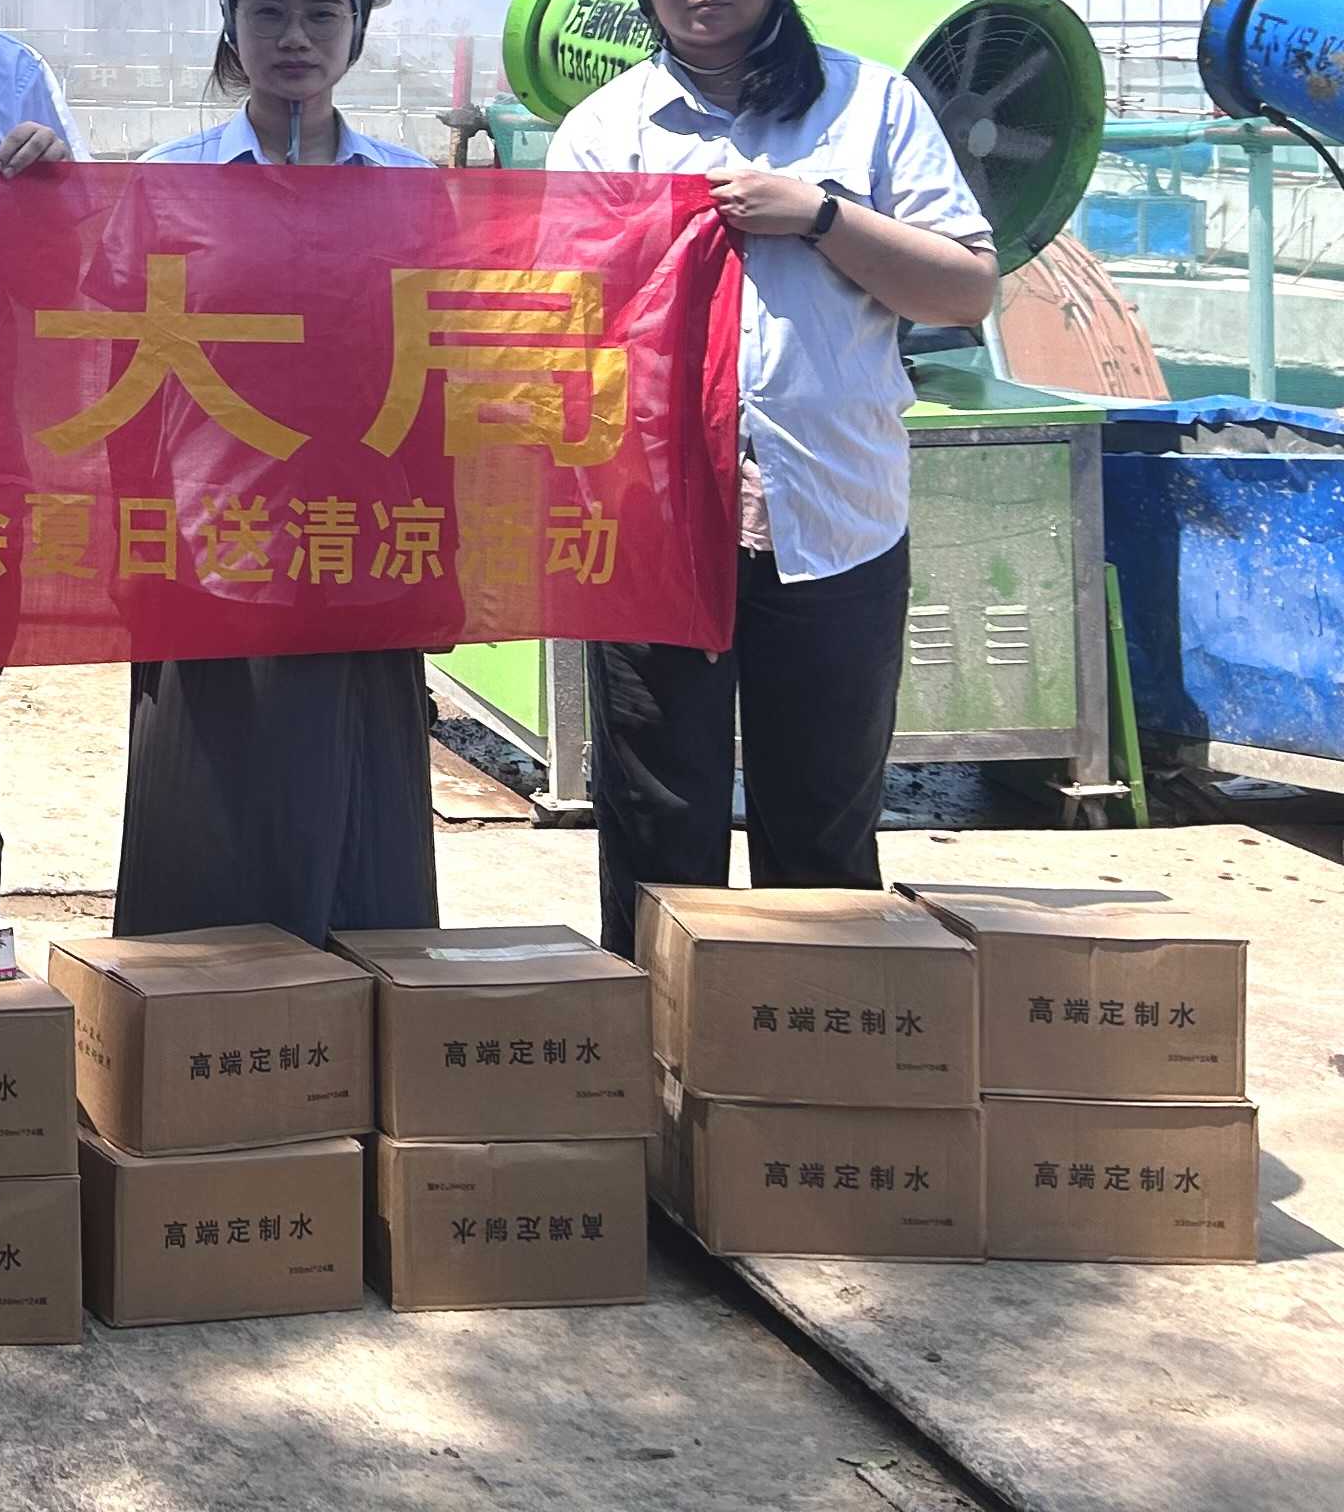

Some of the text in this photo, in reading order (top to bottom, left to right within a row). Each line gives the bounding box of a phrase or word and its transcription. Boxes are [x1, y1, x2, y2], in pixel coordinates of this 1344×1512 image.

[752, 1005, 924, 1037] 高端定制水
[1028, 996, 1197, 1029] 高端定制水
[189, 1041, 331, 1082] 高端定制水
[443, 1041, 602, 1068] 高端定制水
[764, 1161, 930, 1192] 高端定制水
[1033, 1161, 1202, 1193] 高端定制水
[163, 1212, 314, 1249] 高端定制水
[451, 1212, 605, 1243] 高端定制水
